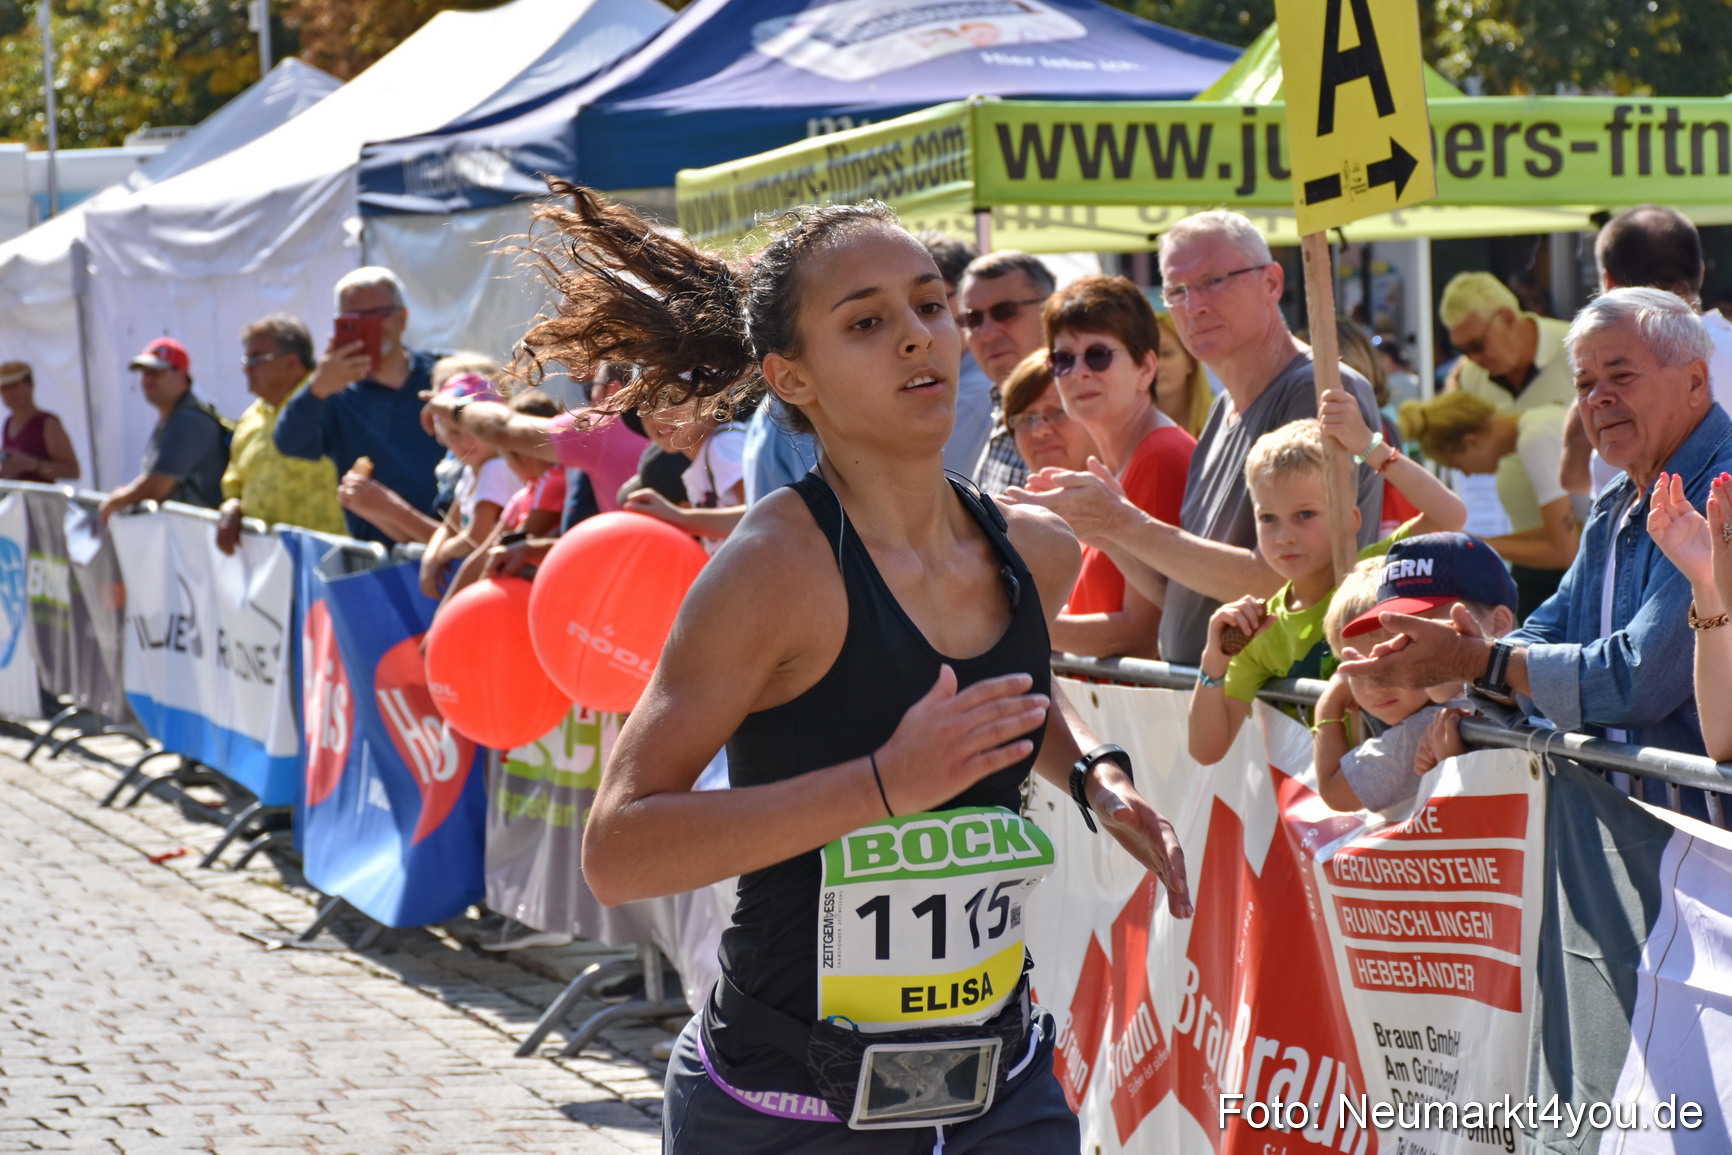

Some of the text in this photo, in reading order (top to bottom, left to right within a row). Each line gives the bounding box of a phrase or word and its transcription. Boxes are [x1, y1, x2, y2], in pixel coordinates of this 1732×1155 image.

[1316, 0, 1396, 137] A
[995, 104, 1732, 196] www.juers-fitn
[847, 818, 1033, 872] BOCK
[1332, 853, 1501, 885] VERZURRSYSTEME
[855, 878, 1025, 961] 1115
[1341, 905, 1494, 940] RUNDSCHLINGEN
[901, 971, 994, 1014] ELISA
[1354, 955, 1476, 993] HEBEBÄNDER
[1373, 1022, 1462, 1059] Braun GmbH
[1384, 1054, 1410, 1083] Am
